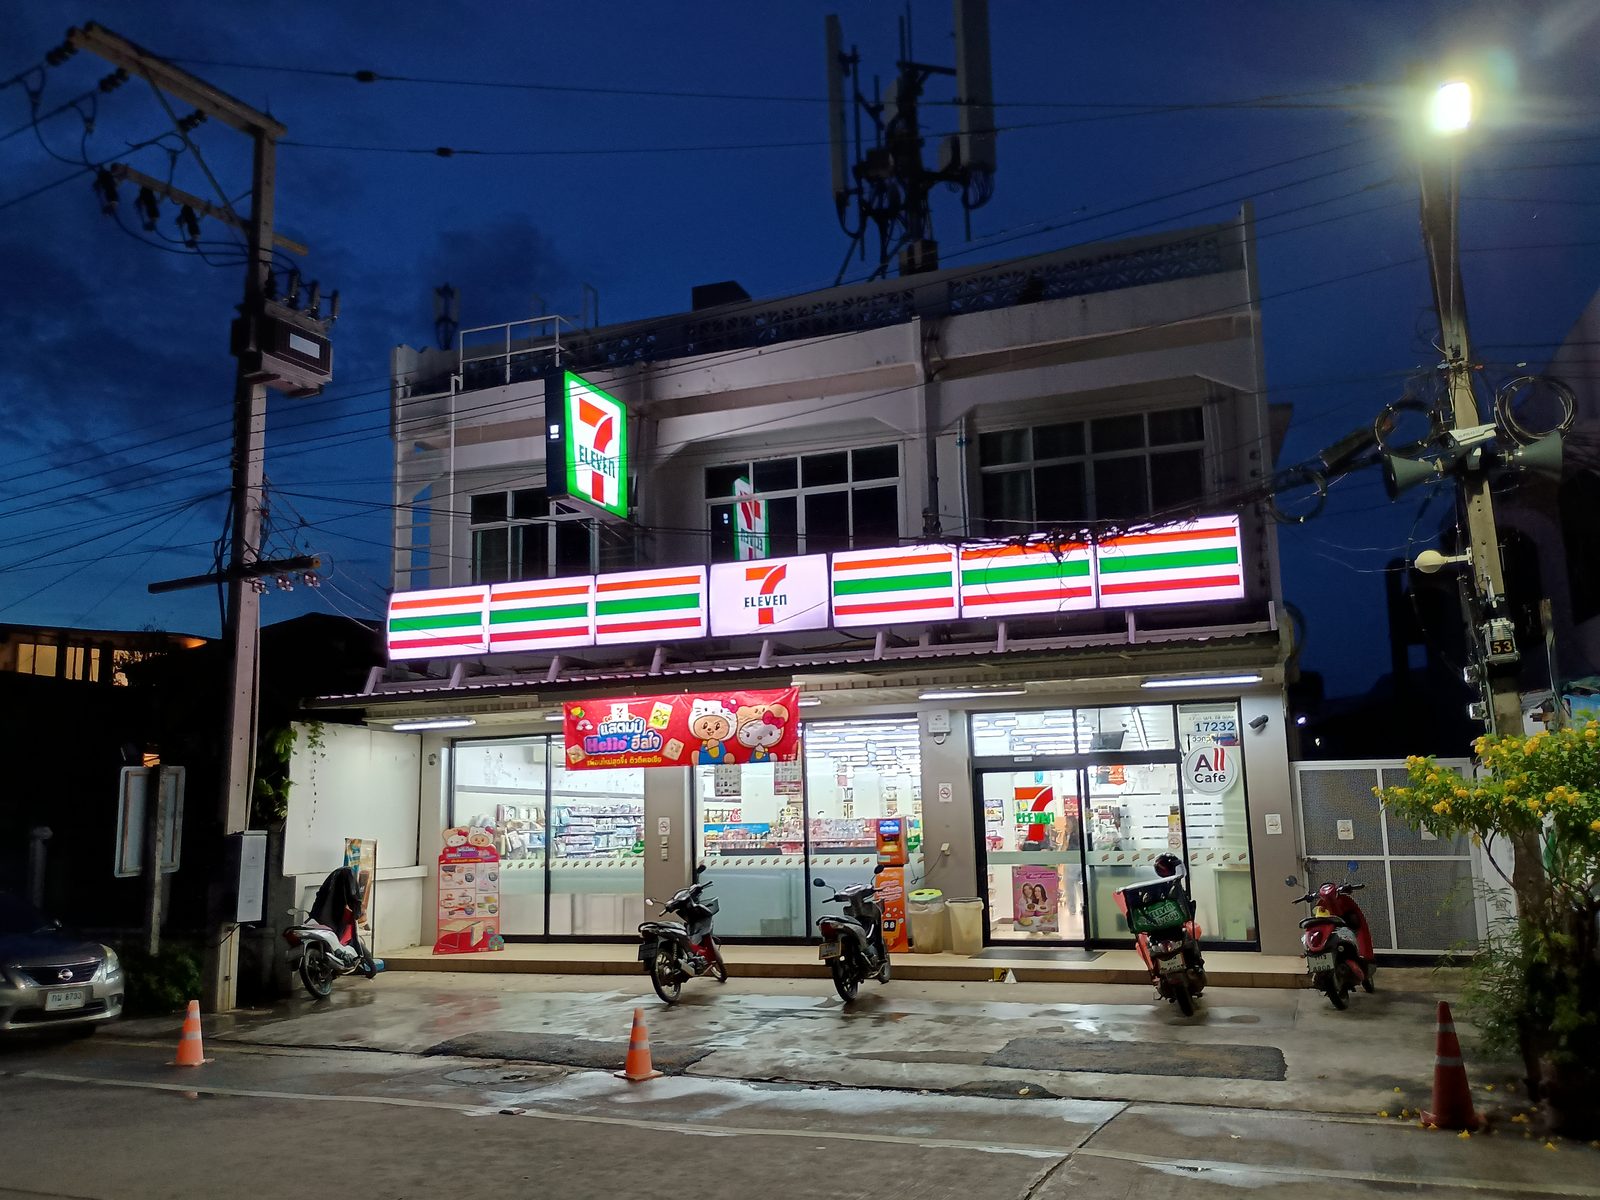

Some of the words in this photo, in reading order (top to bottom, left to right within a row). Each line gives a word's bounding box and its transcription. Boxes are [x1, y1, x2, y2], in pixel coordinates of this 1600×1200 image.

[579, 397, 614, 504] 7
[745, 563, 787, 625] 7
[1492, 640, 1513, 654] 53
[600, 718, 644, 736] แสตมป์
[1194, 721, 1235, 732] 17232
[586, 736, 628, 753] Hello
[631, 731, 661, 750] ฮีลใจ
[1194, 747, 1225, 772] All
[1194, 771, 1226, 784] Café
[1014, 786, 1053, 841] 7
